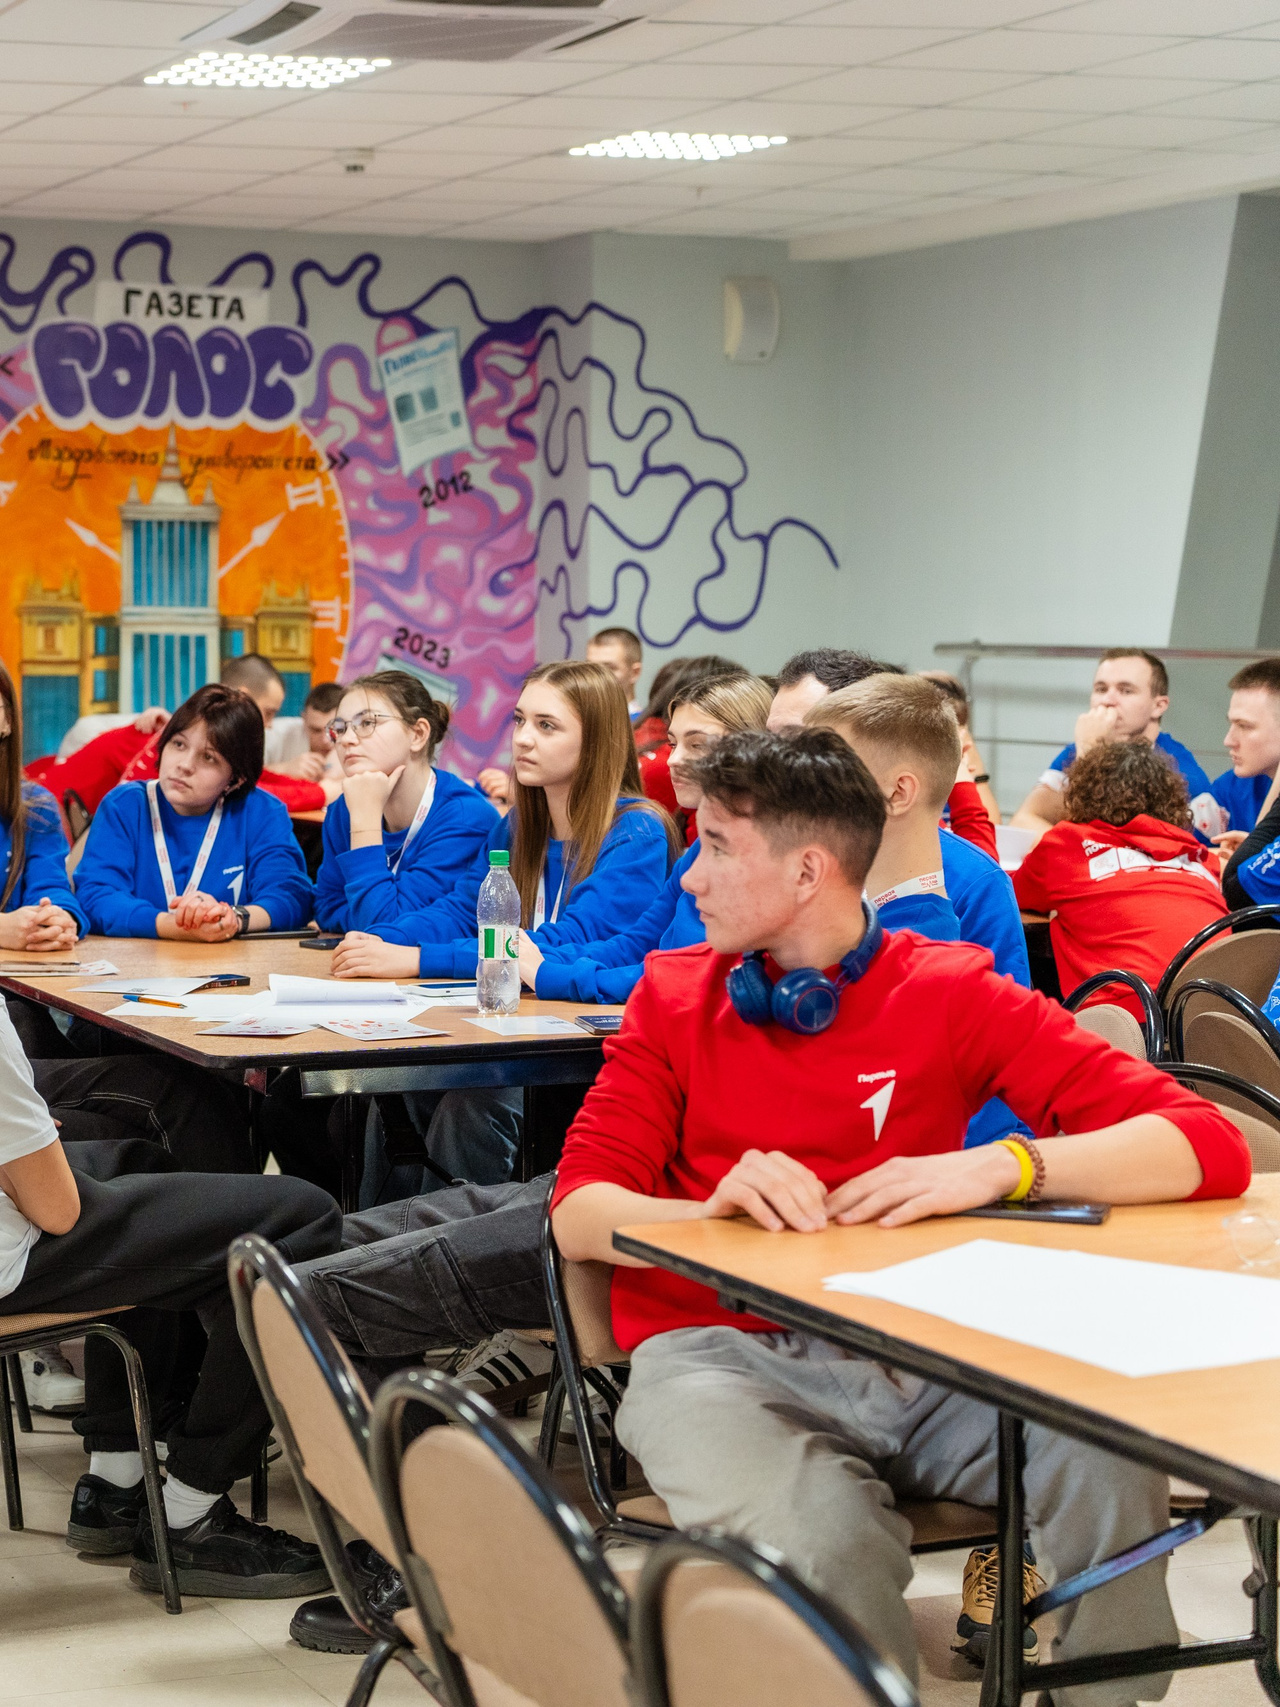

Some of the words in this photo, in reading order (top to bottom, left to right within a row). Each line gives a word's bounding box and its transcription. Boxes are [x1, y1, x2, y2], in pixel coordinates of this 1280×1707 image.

[123, 288, 246, 321] ГАЗЕТА
[31, 320, 314, 424] ГОЛОС
[419, 471, 472, 508] 2012
[394, 626, 450, 669] 2023
